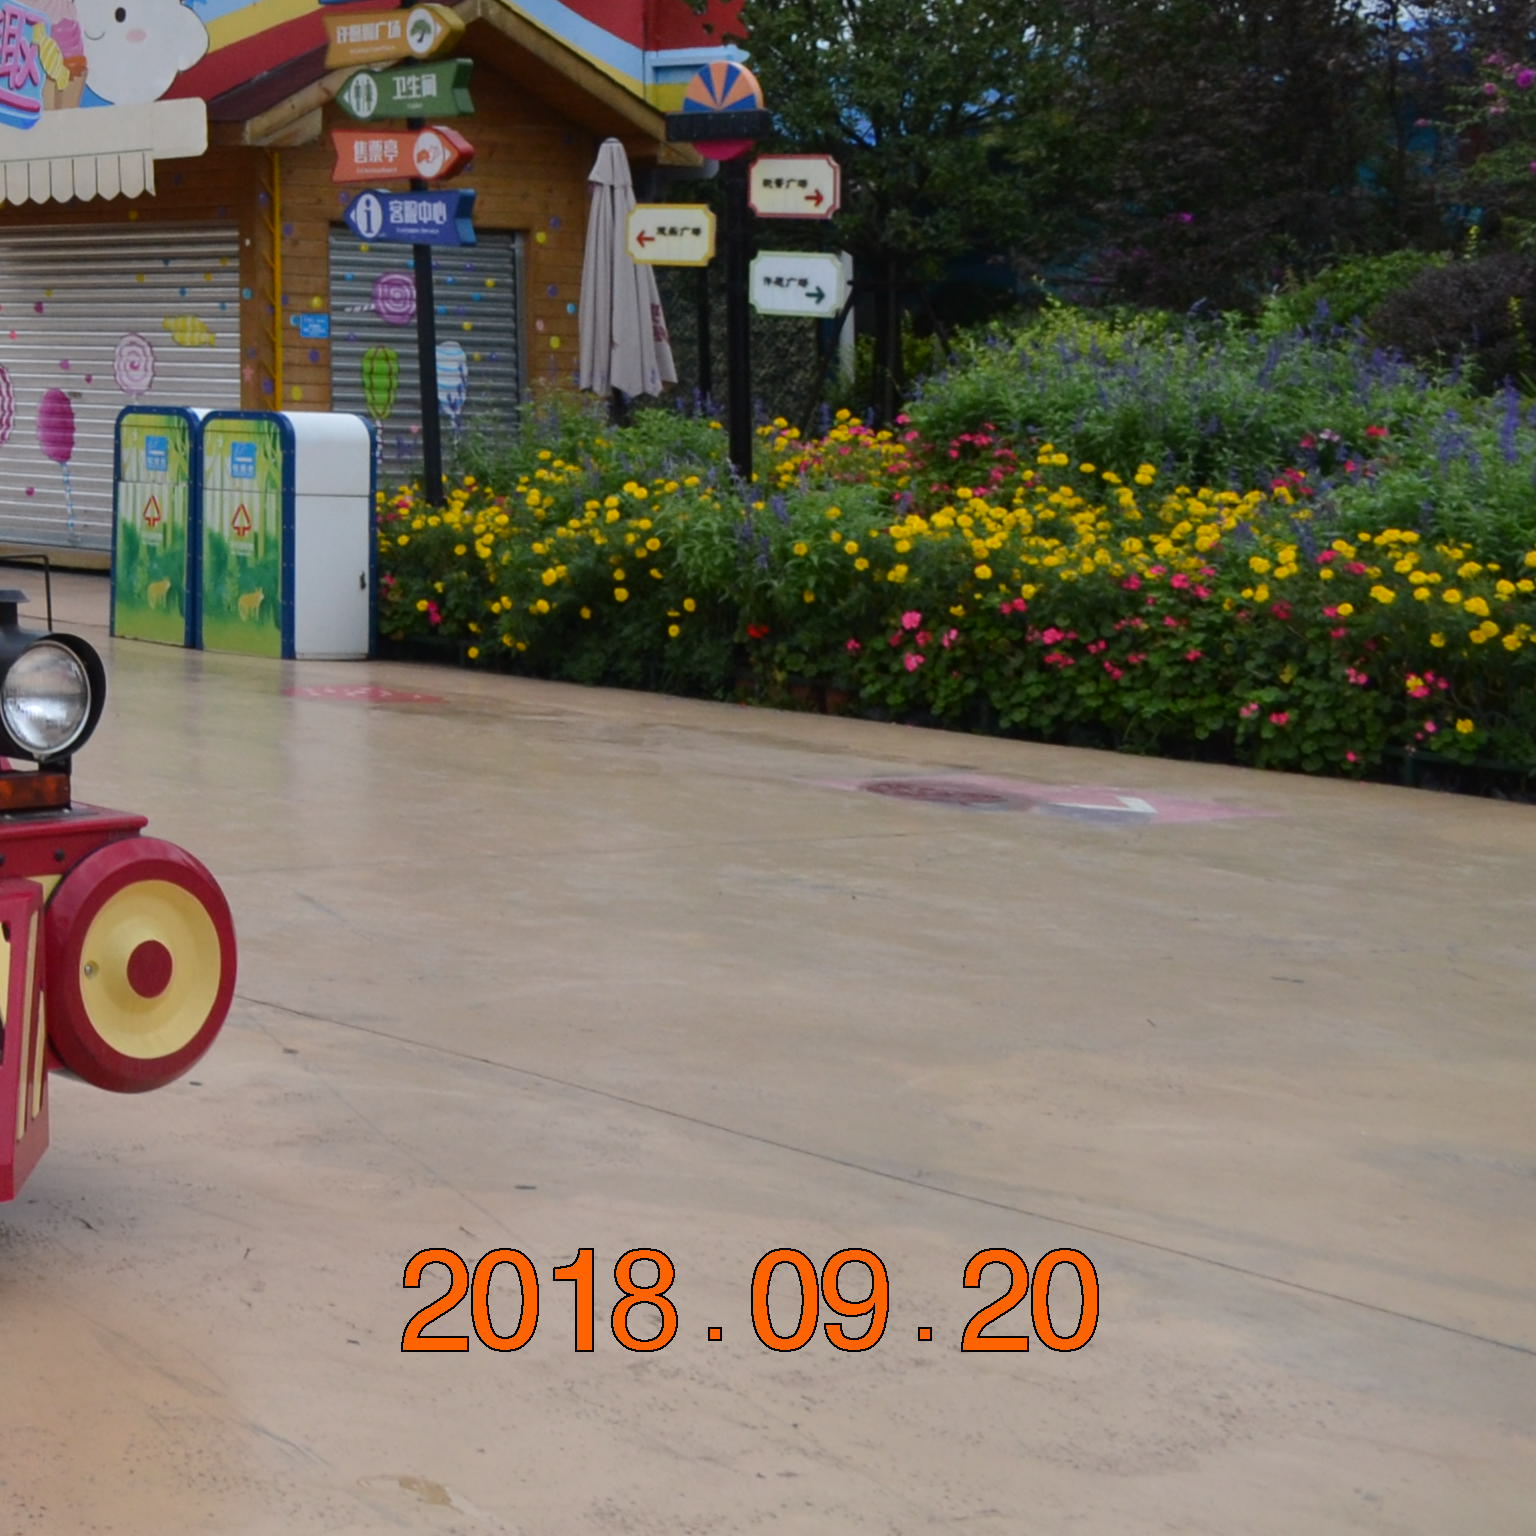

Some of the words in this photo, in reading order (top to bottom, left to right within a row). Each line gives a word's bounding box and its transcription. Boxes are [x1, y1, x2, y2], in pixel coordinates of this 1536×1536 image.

[391, 73, 438, 100] 卫生间
[354, 139, 399, 164] 售票亭
[388, 199, 448, 225] 客服中心
